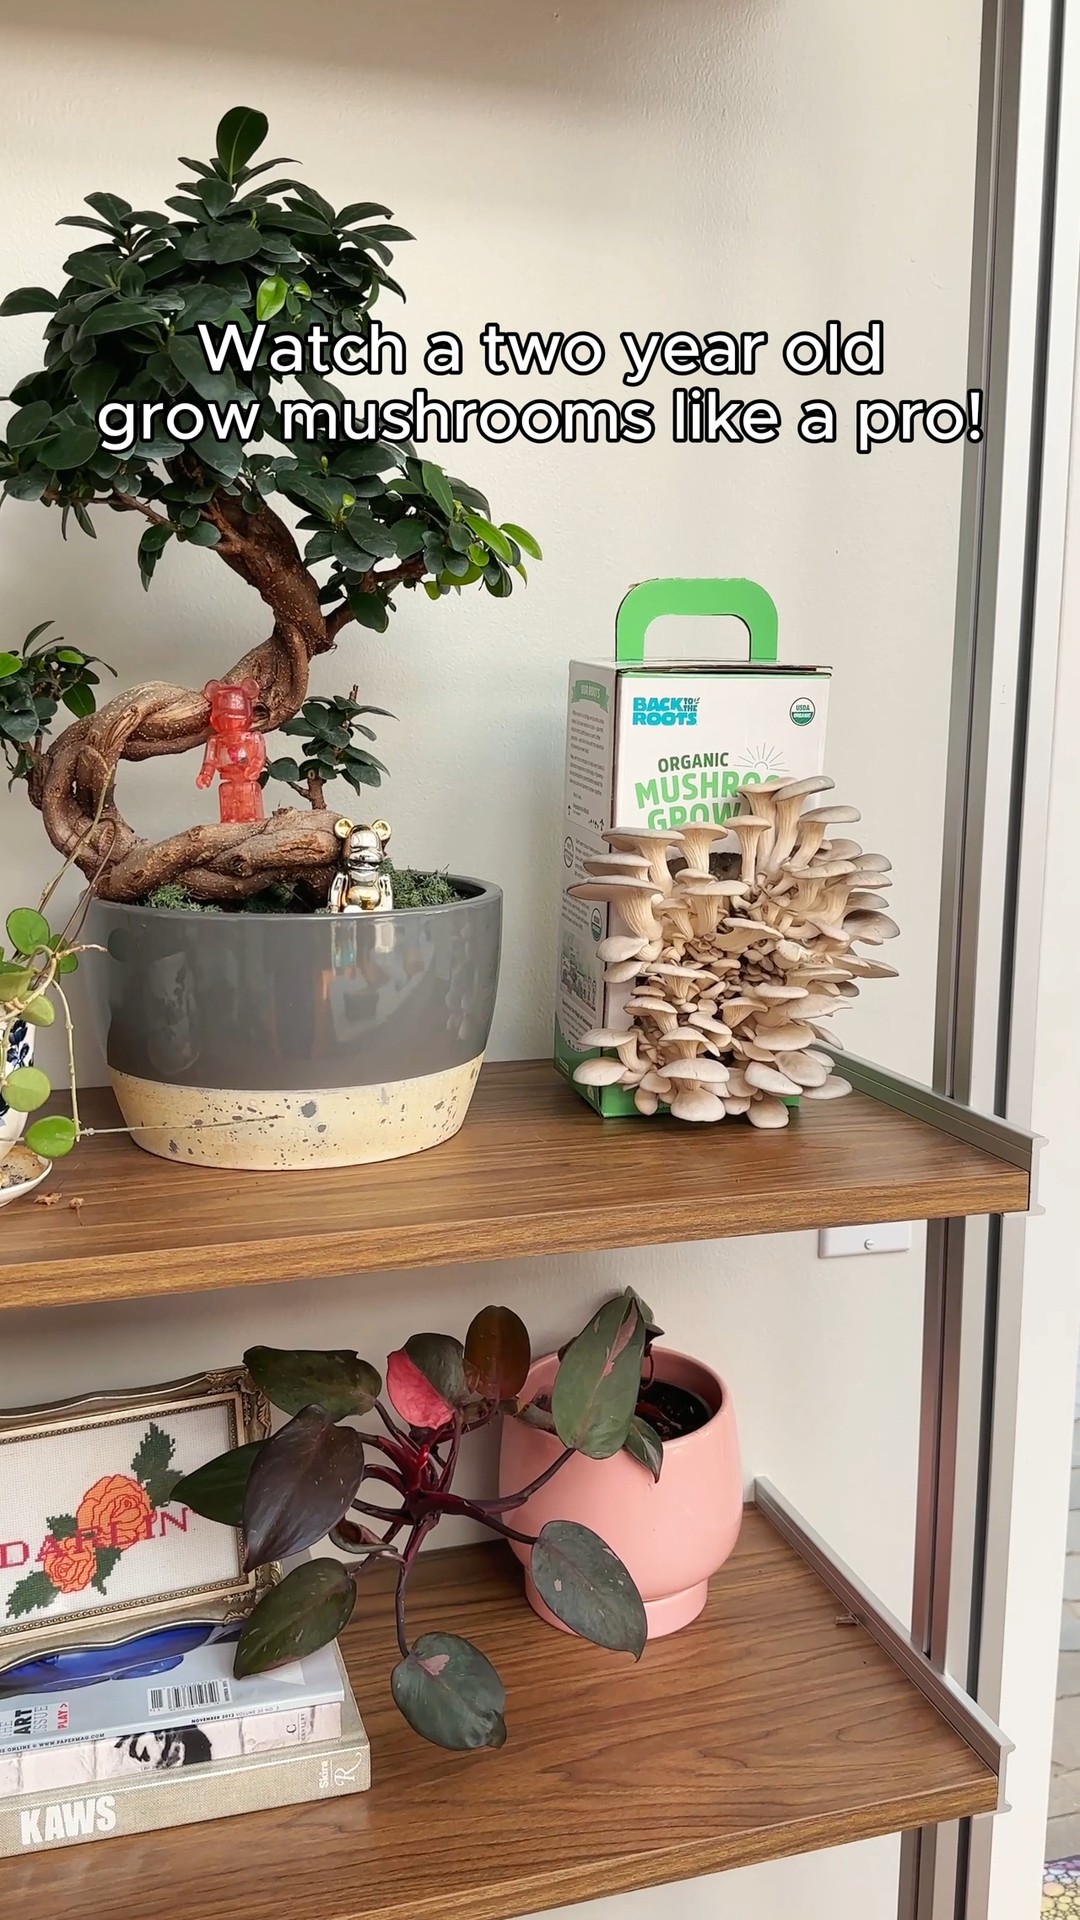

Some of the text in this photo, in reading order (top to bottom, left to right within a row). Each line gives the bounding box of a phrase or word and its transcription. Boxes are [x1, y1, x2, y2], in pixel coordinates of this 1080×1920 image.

[633, 697, 684, 711] BACK
[632, 712, 697, 726] ROOTS
[658, 752, 729, 773] ORGANIC
[634, 771, 781, 809] MUSHRO
[647, 802, 741, 831] GROW
[0, 1506, 190, 1568] DARLIN
[13, 1709, 33, 1735] ART
[33, 1705, 49, 1733] ISSUE
[57, 1710, 68, 1730] PLAY
[191, 1715, 220, 1723] NOVEMBER
[235, 1709, 256, 1717] VOLUME
[285, 1723, 297, 1734] C
[319, 1760, 329, 1788] Skira
[334, 1751, 363, 1787] R
[20, 1795, 117, 1846] KAWS
